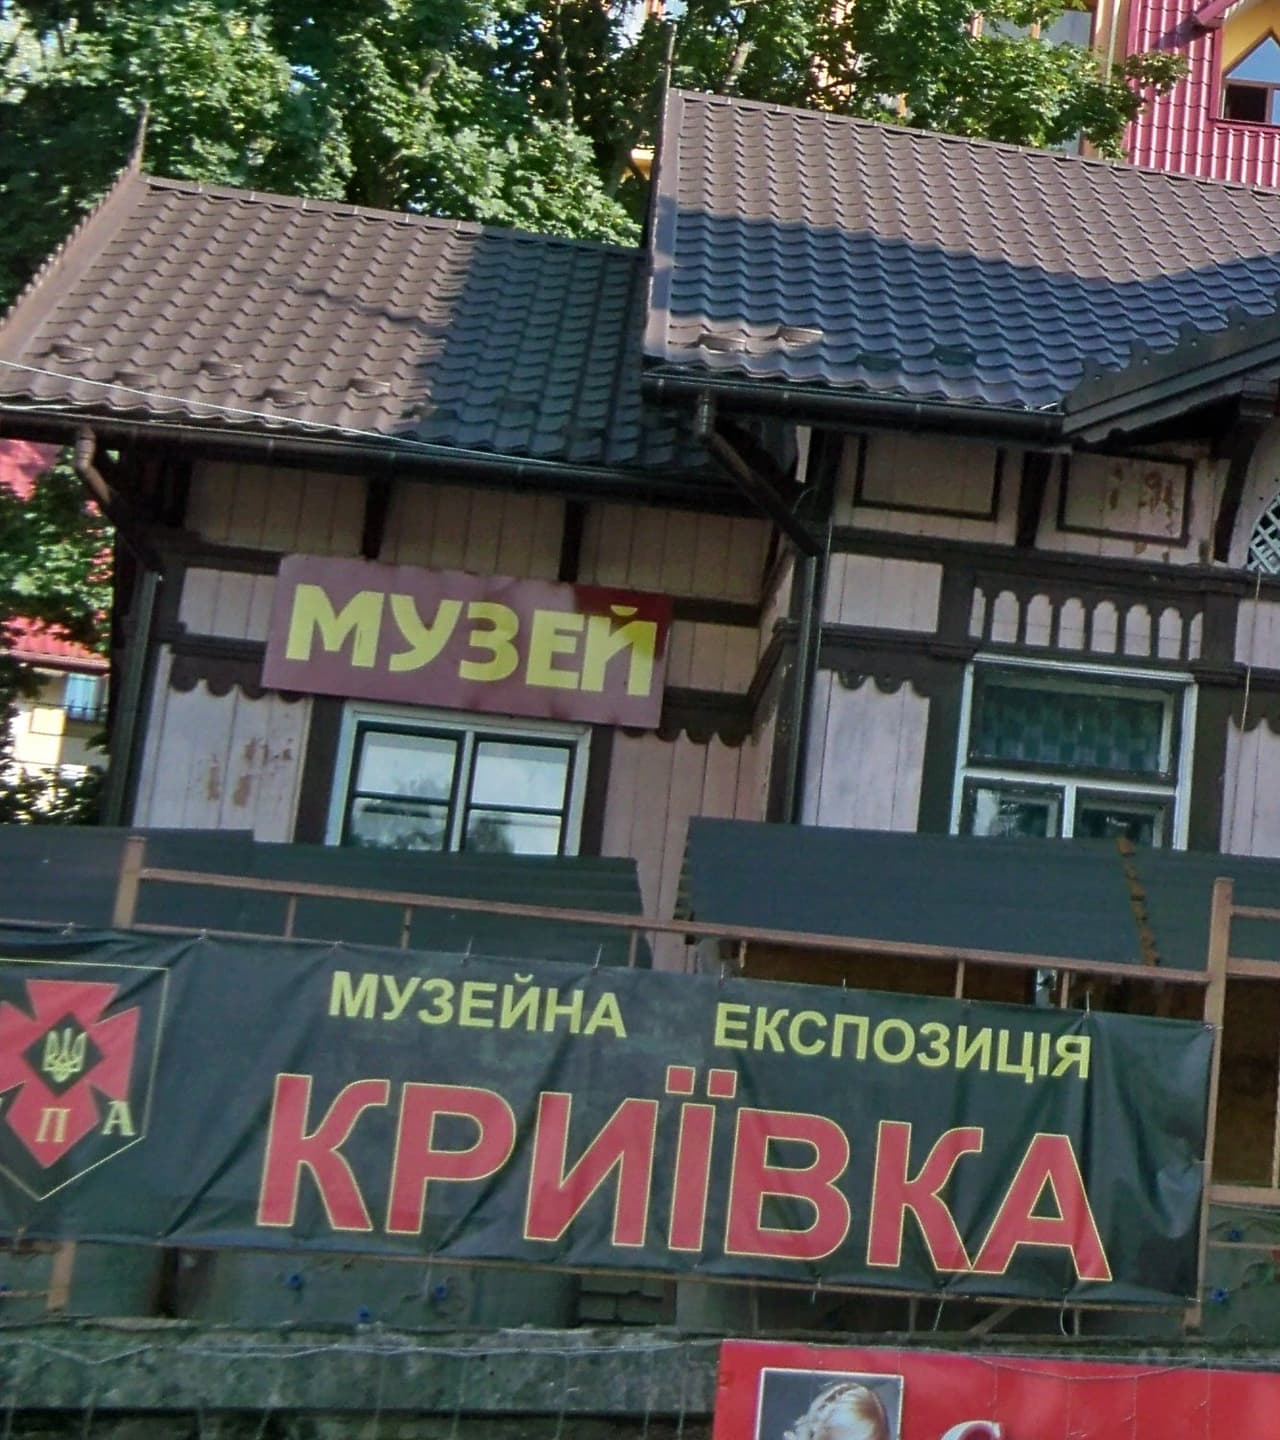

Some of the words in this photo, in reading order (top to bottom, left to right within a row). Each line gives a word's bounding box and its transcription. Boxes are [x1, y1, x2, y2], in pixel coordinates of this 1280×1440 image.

[285, 583, 658, 697] МУЗЕЙ
[329, 971, 627, 1038] МУЗЕЙНА
[713, 1002, 1093, 1082] ЕКСПОЗИЦІЯ
[256, 1065, 1112, 1282] КРИЇВКА
